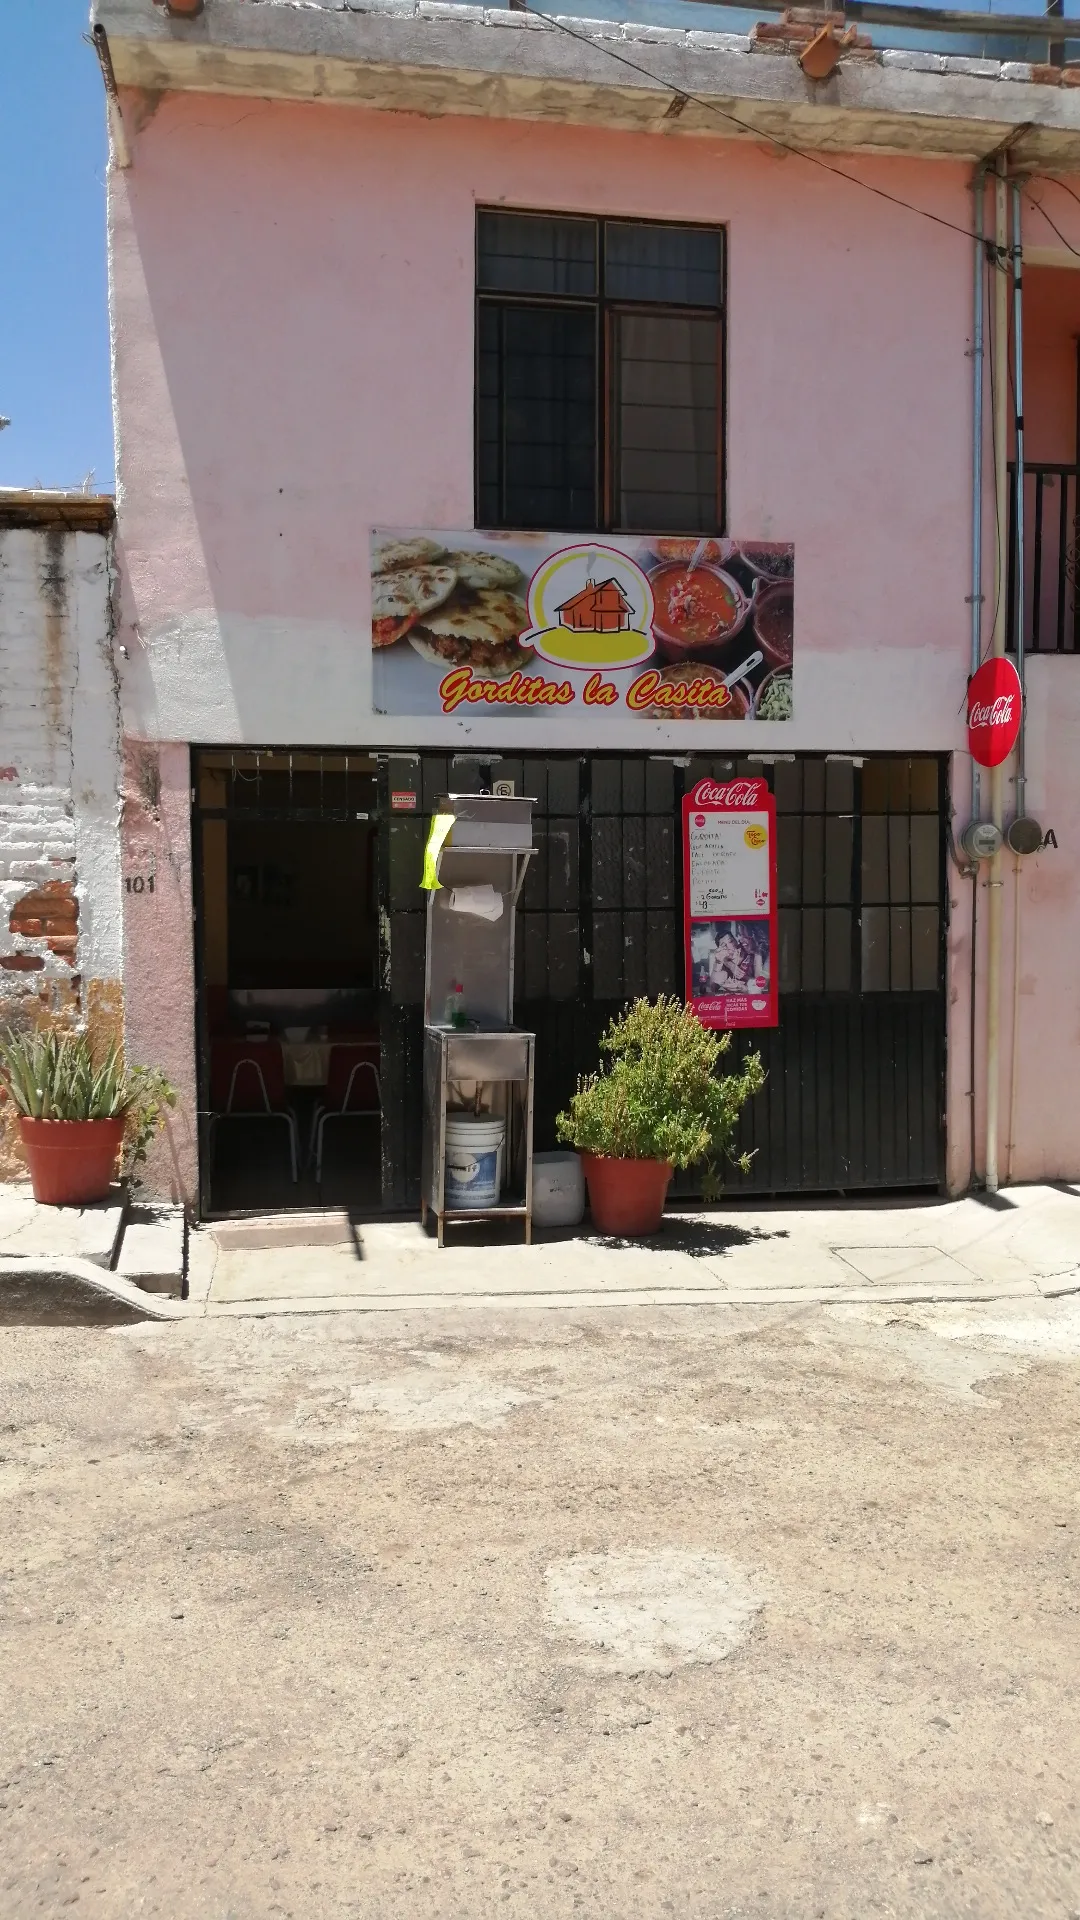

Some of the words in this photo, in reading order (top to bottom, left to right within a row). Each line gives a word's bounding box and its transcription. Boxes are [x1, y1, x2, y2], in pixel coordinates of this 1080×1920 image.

[439, 666, 575, 713] Gorditas
[583, 673, 618, 706] la
[626, 669, 731, 710] Casita
[125, 876, 155, 893] 101
